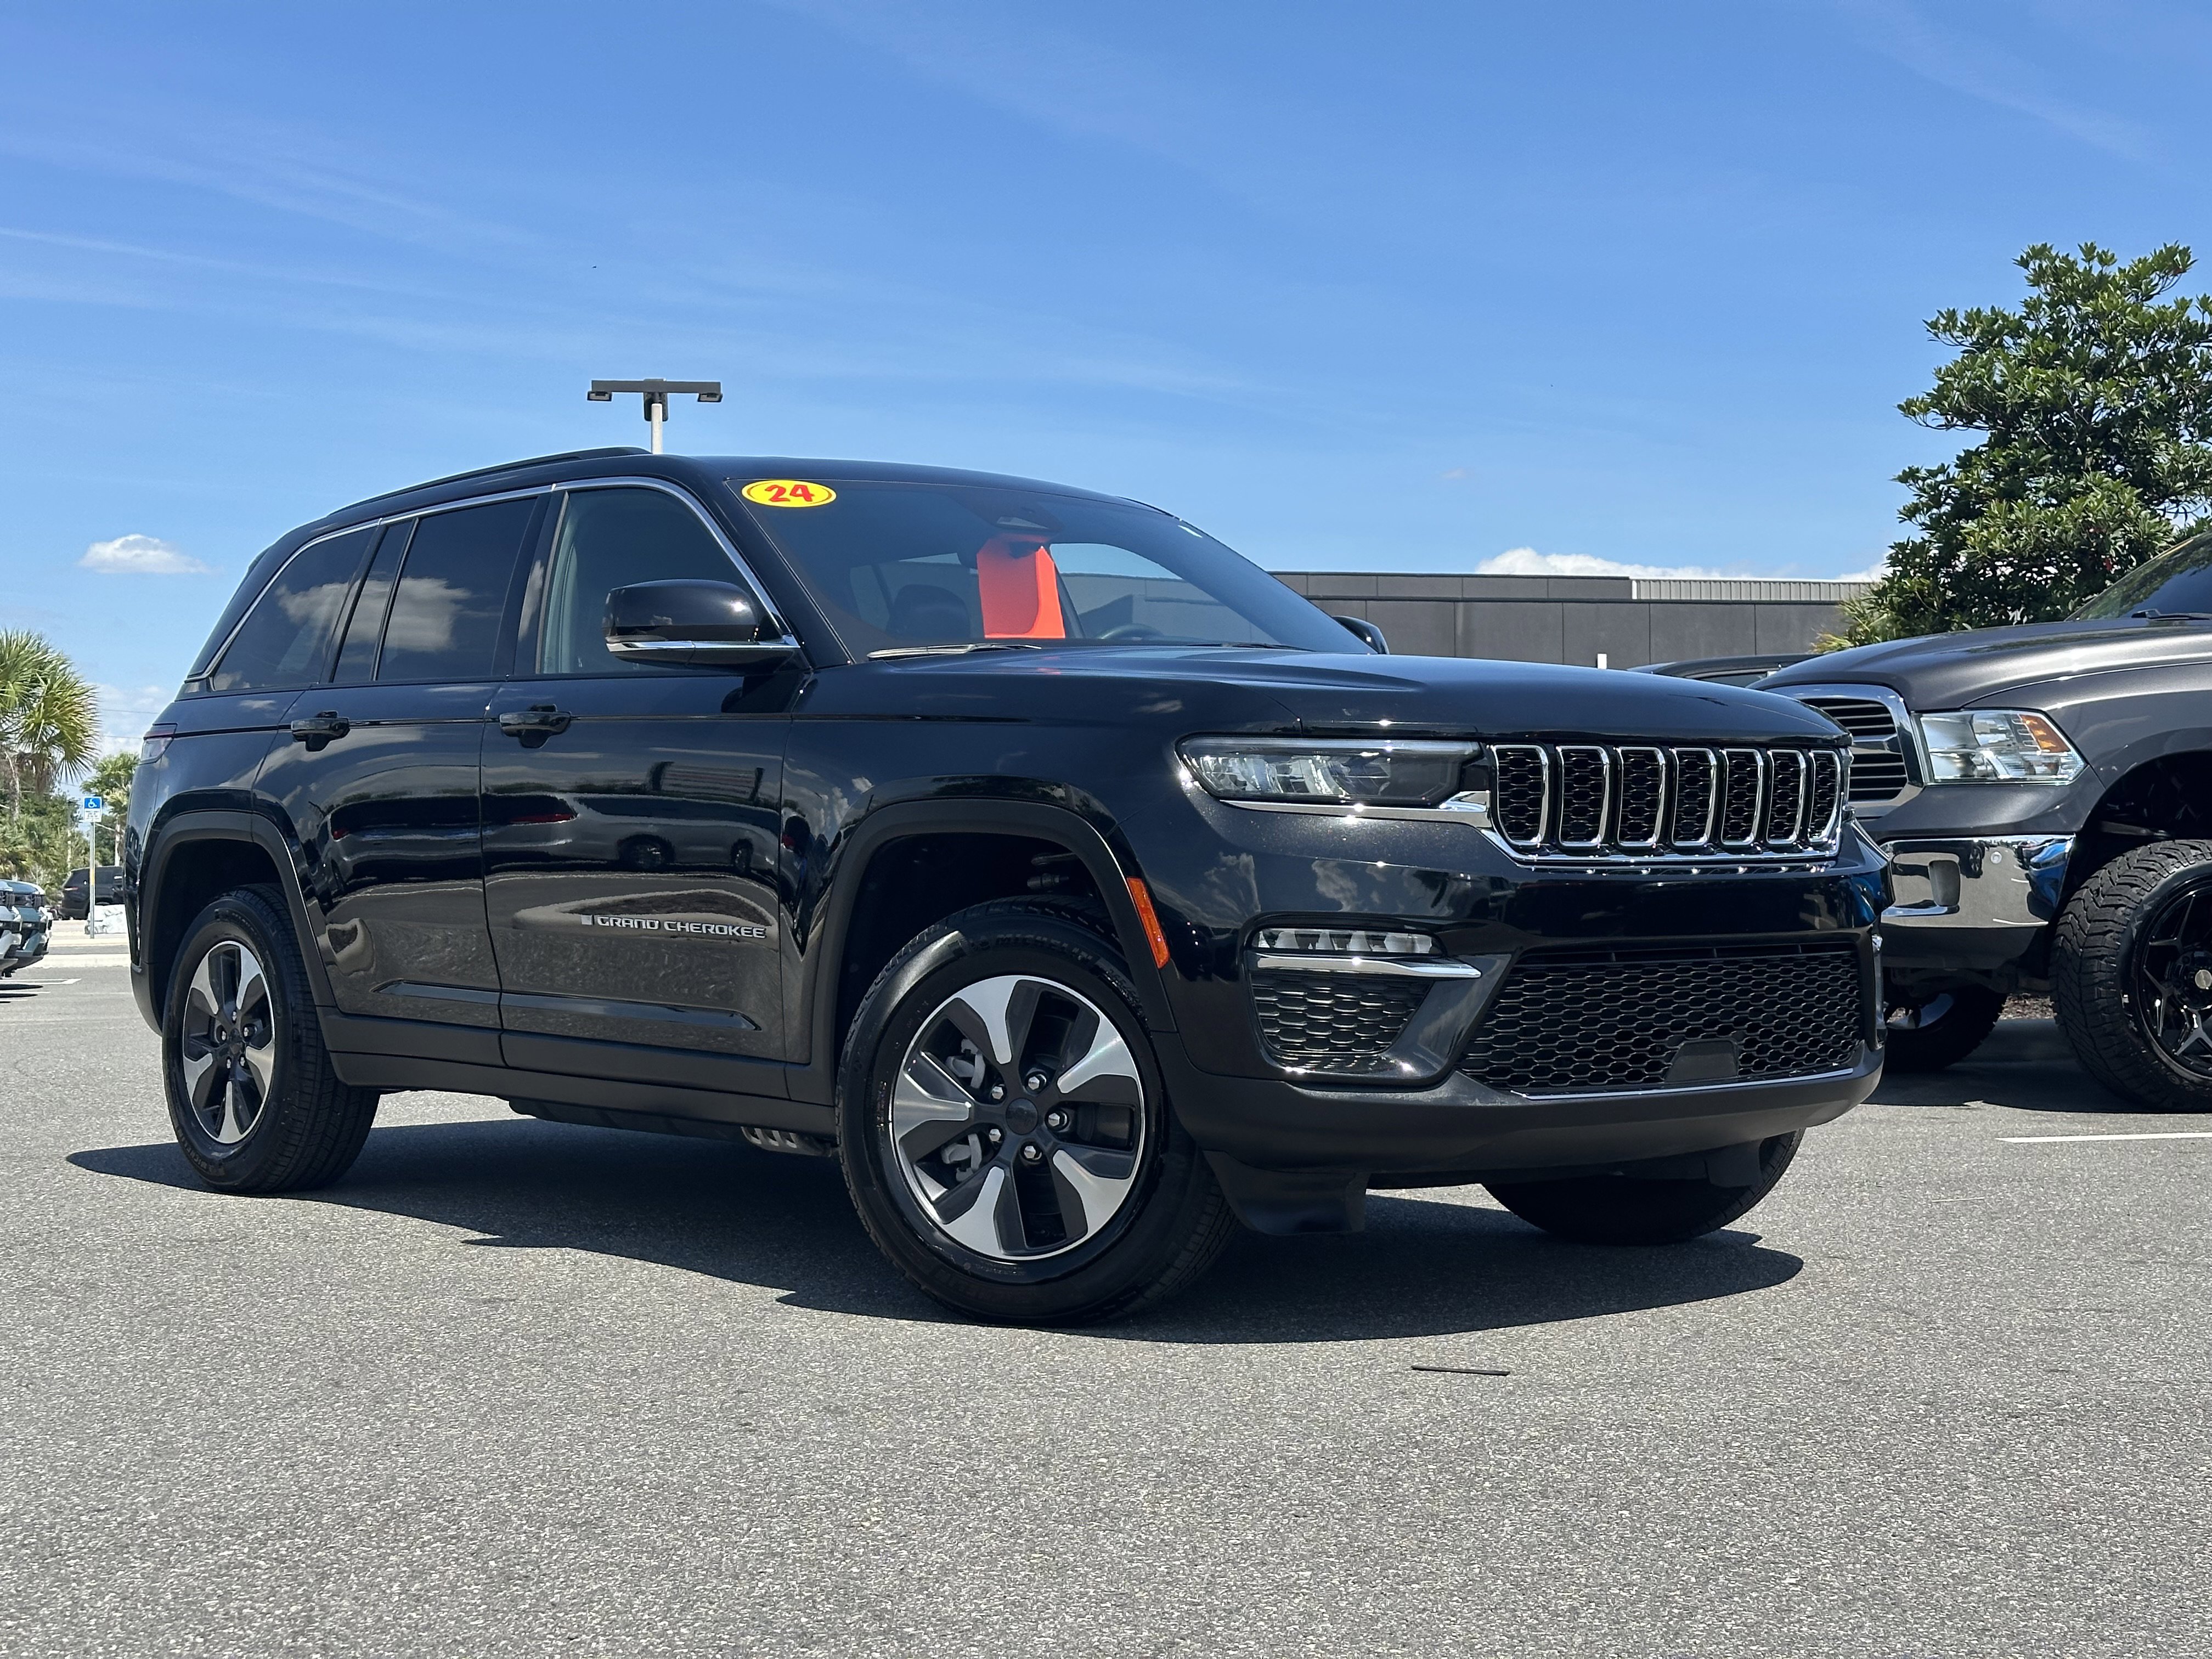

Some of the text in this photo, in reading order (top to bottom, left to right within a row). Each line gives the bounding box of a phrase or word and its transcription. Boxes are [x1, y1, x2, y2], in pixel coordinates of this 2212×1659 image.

[765, 484, 815, 502] 24
[597, 916, 766, 938] GRAND CHEROKEE
